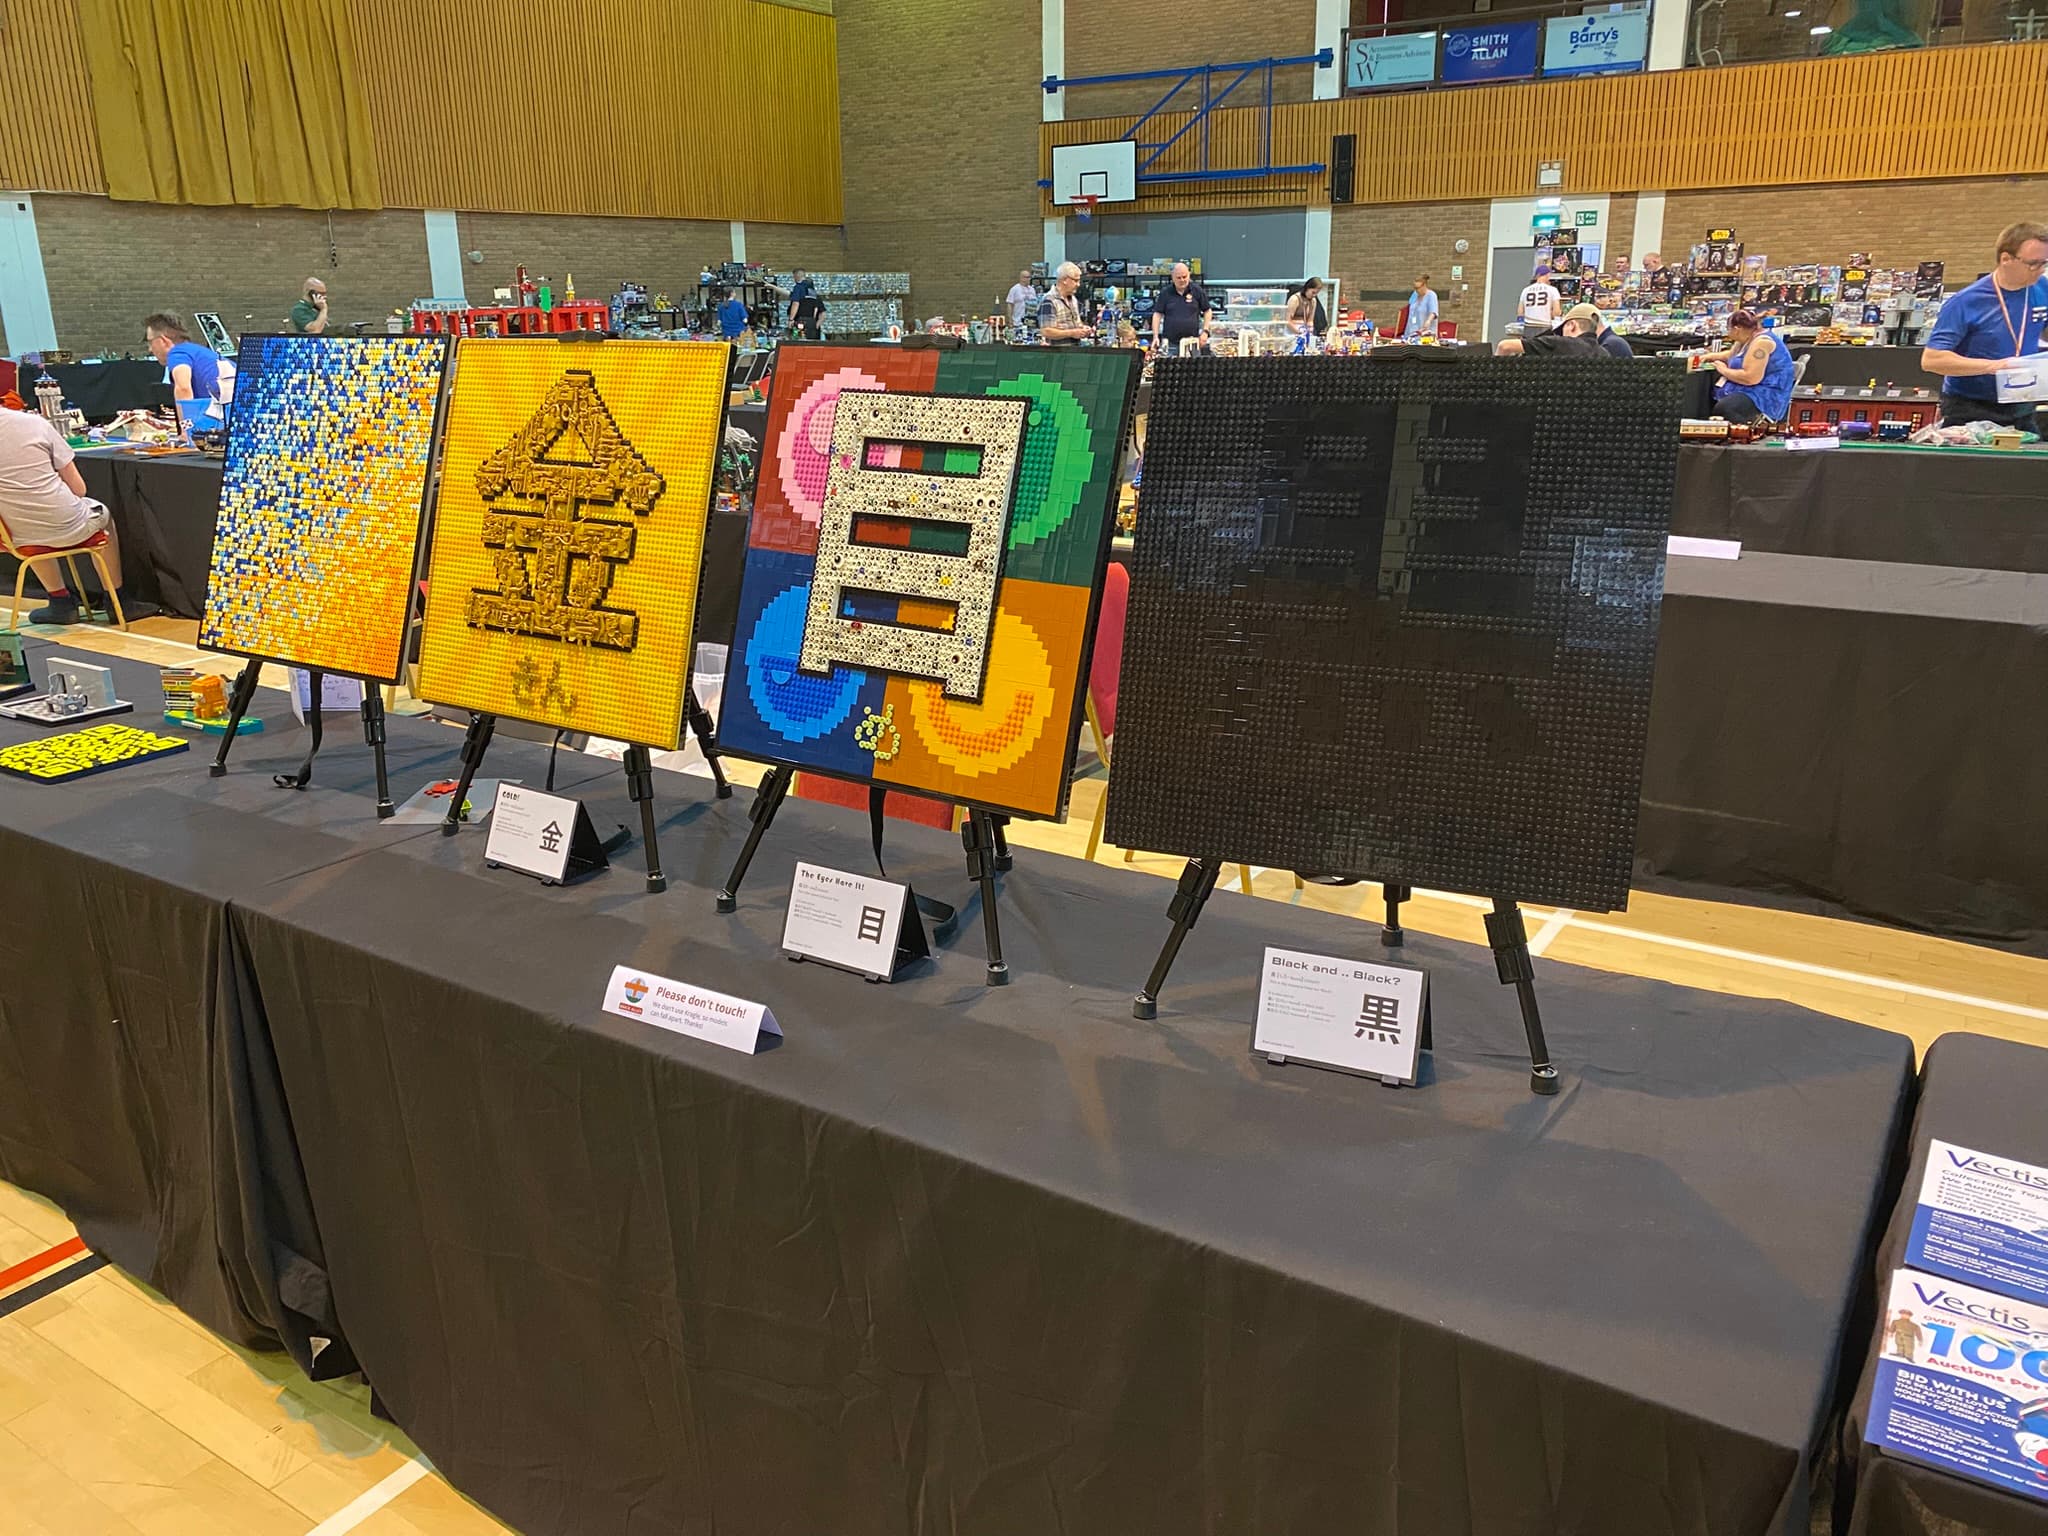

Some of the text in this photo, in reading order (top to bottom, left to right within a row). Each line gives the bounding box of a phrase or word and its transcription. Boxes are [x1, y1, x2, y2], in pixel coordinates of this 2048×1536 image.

[1472, 34, 1509, 47] SMITH
[1570, 27, 1618, 44] Barry's
[1356, 42, 1368, 64] S
[1472, 47, 1508, 60] ALLAN
[1356, 61, 1379, 82] W
[1526, 292, 1548, 306] 93
[539, 820, 564, 854] 金
[801, 870, 865, 891] The Eyes Have It!
[857, 905, 886, 945] 目
[1272, 956, 1309, 971] Black
[1312, 964, 1338, 976] and
[1353, 970, 1401, 986] Black?
[656, 986, 747, 1019] Please don't touch!
[1354, 993, 1402, 1045] 黒
[1942, 1169, 2016, 1193] Collectable
[1946, 1150, 2048, 1187] Vectis
[1942, 1176, 1961, 1184] We
[1964, 1182, 2013, 1199] Auction
[1912, 1282, 2030, 1330] Vectis
[1924, 1315, 1956, 1326] OVER
[1897, 1369, 2006, 1410] BID WITH US
[1927, 1357, 2040, 1391] Auctions Per
[1894, 1391, 1986, 1425] VARIETY OF GENRES
[1895, 1386, 1926, 1400] HOUSE
[1934, 1400, 1980, 1418] COVERING
[1992, 1418, 2018, 1430] WIDE
[1896, 1376, 1989, 1410] WE SELL MORE LOTS
[1896, 1381, 2018, 1424] THAN ANY OTHER AUCTION
